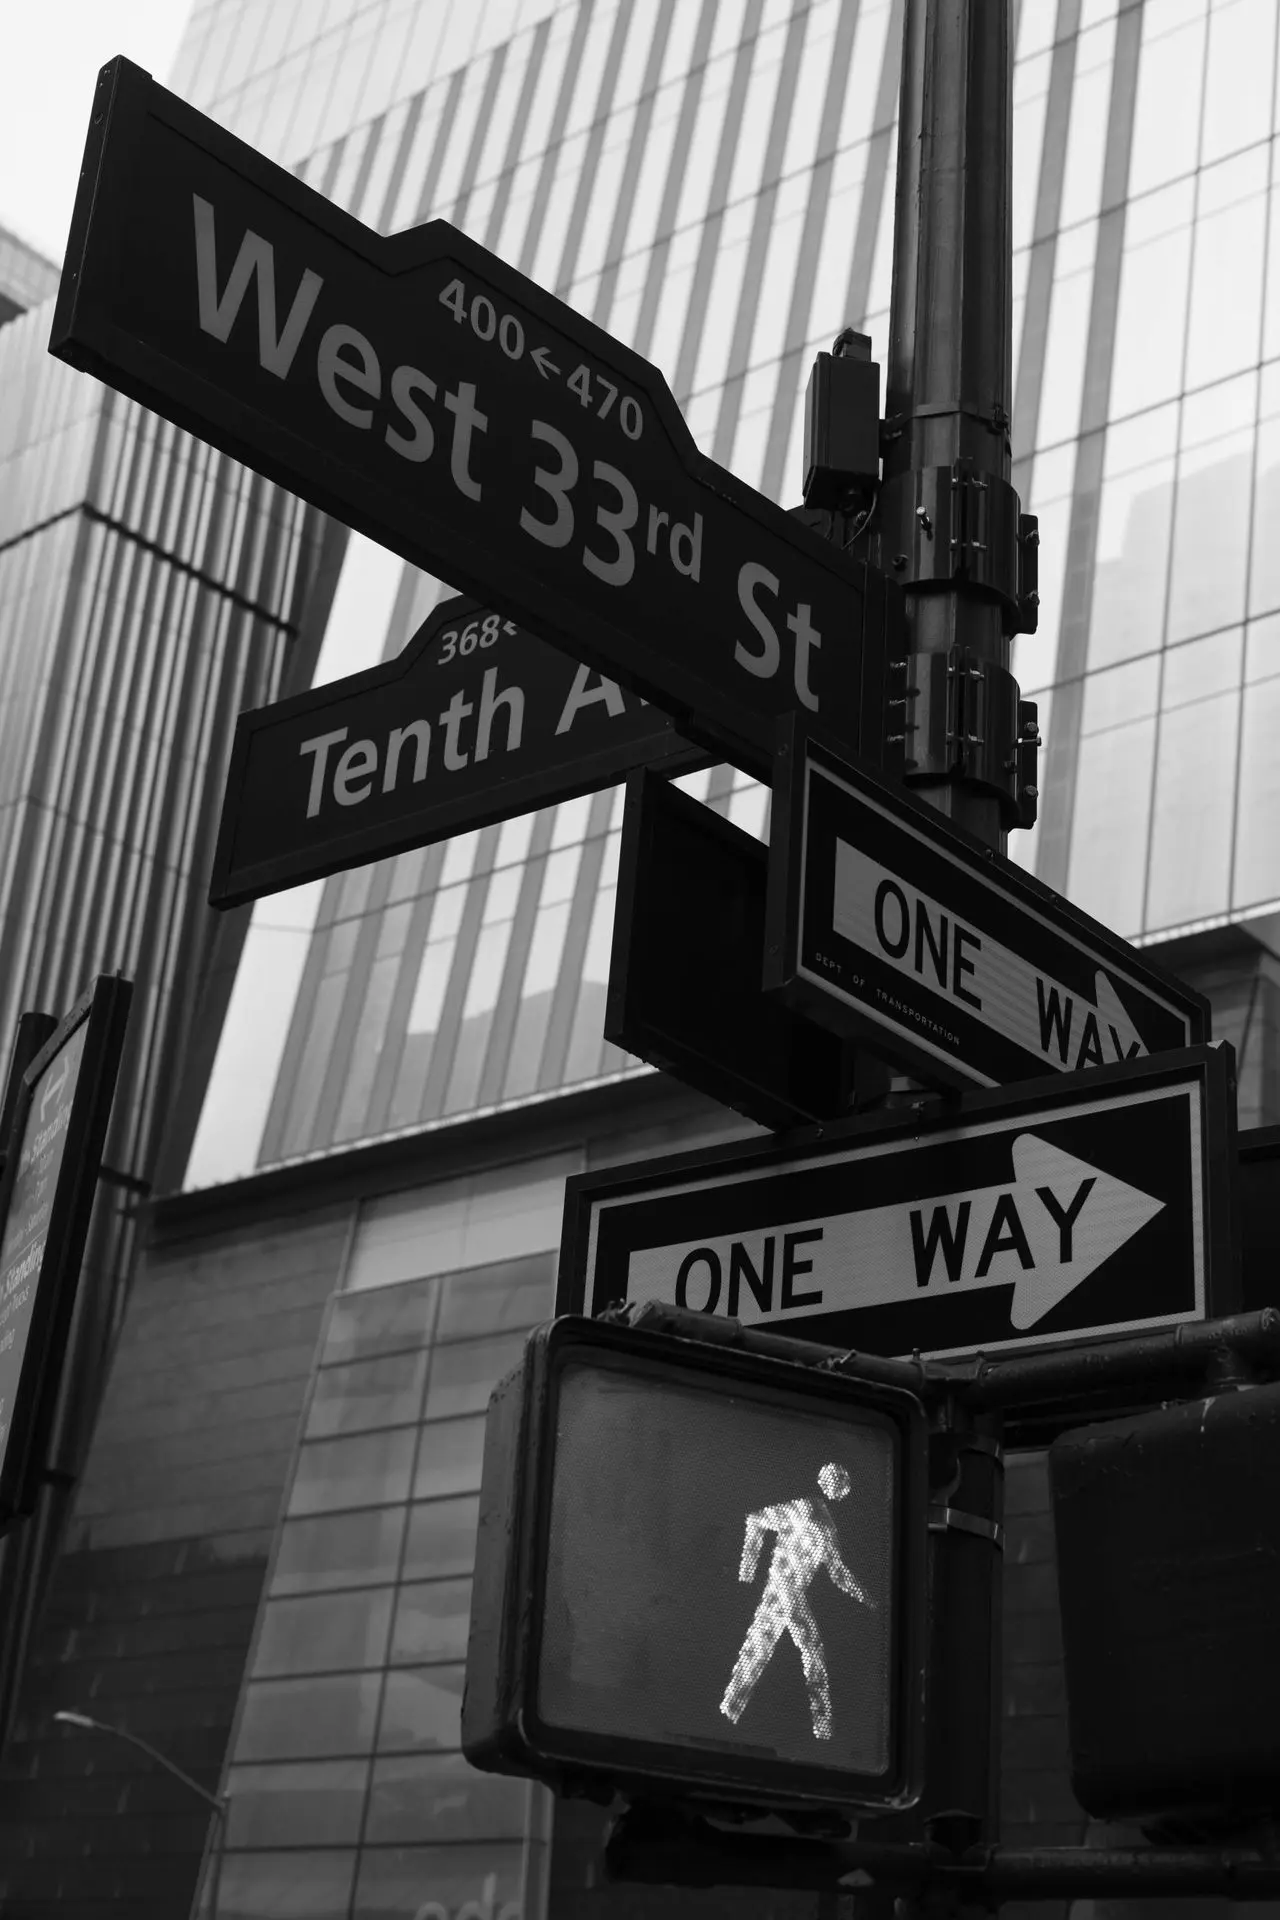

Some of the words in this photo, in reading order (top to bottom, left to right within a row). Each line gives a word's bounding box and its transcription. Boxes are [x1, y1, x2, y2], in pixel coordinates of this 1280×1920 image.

[439, 278, 525, 363] 400
[565, 363, 644, 441] 470
[192, 193, 488, 503] West
[518, 420, 704, 587] 33rd
[734, 561, 822, 712] St
[438, 614, 500, 665] 368
[299, 666, 524, 820] Tenth
[814, 952, 842, 974] DEPT
[852, 974, 866, 988] OF
[876, 988, 961, 1046] TRANSPORTATION
[874, 879, 982, 1011] ONE
[675, 1227, 824, 1317] ONE
[909, 1177, 1098, 1287] WAY
